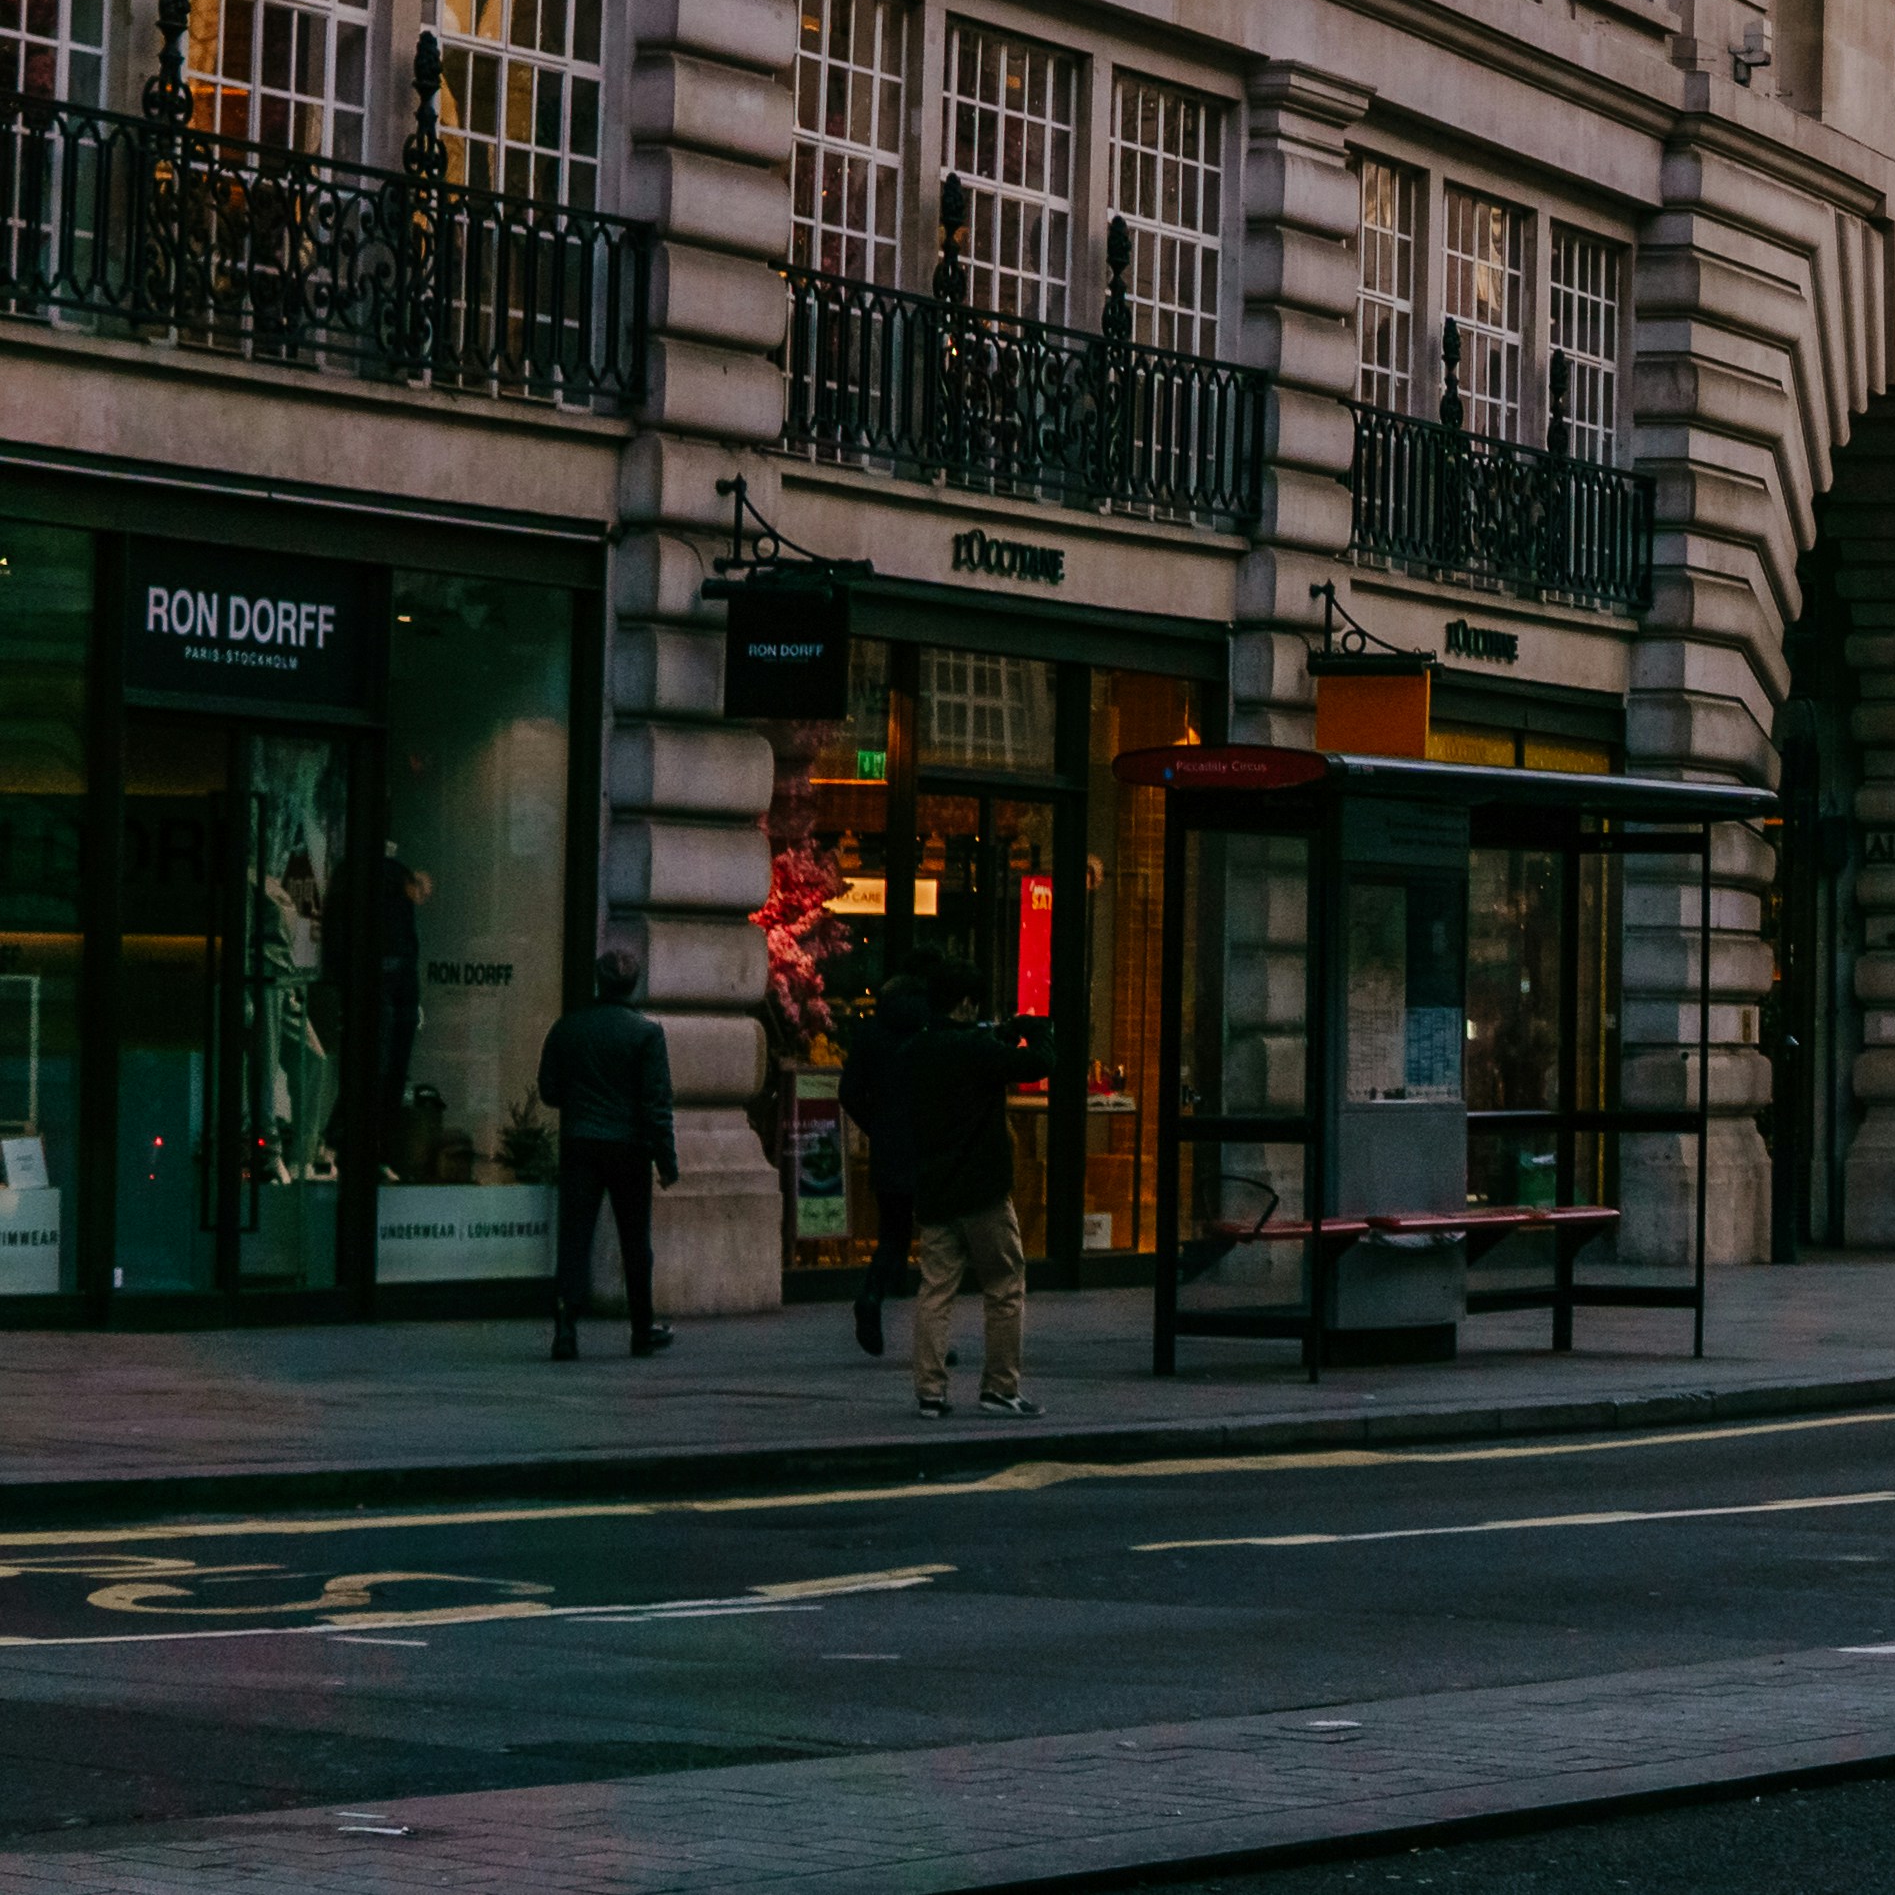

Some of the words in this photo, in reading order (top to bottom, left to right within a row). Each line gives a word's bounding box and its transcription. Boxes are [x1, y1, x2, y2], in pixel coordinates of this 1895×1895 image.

[146, 585, 219, 639] RON
[228, 593, 337, 649] DORFF
[748, 643, 777, 657] RON
[780, 642, 825, 657] DORFF
[1176, 760, 1227, 774] Piccadilly
[1231, 759, 1267, 772] Circus
[427, 961, 461, 984] RON
[464, 962, 513, 986] DORFF
[379, 1222, 455, 1240] UNDERWEAR
[467, 1220, 549, 1238] LOUNGEWEAR
